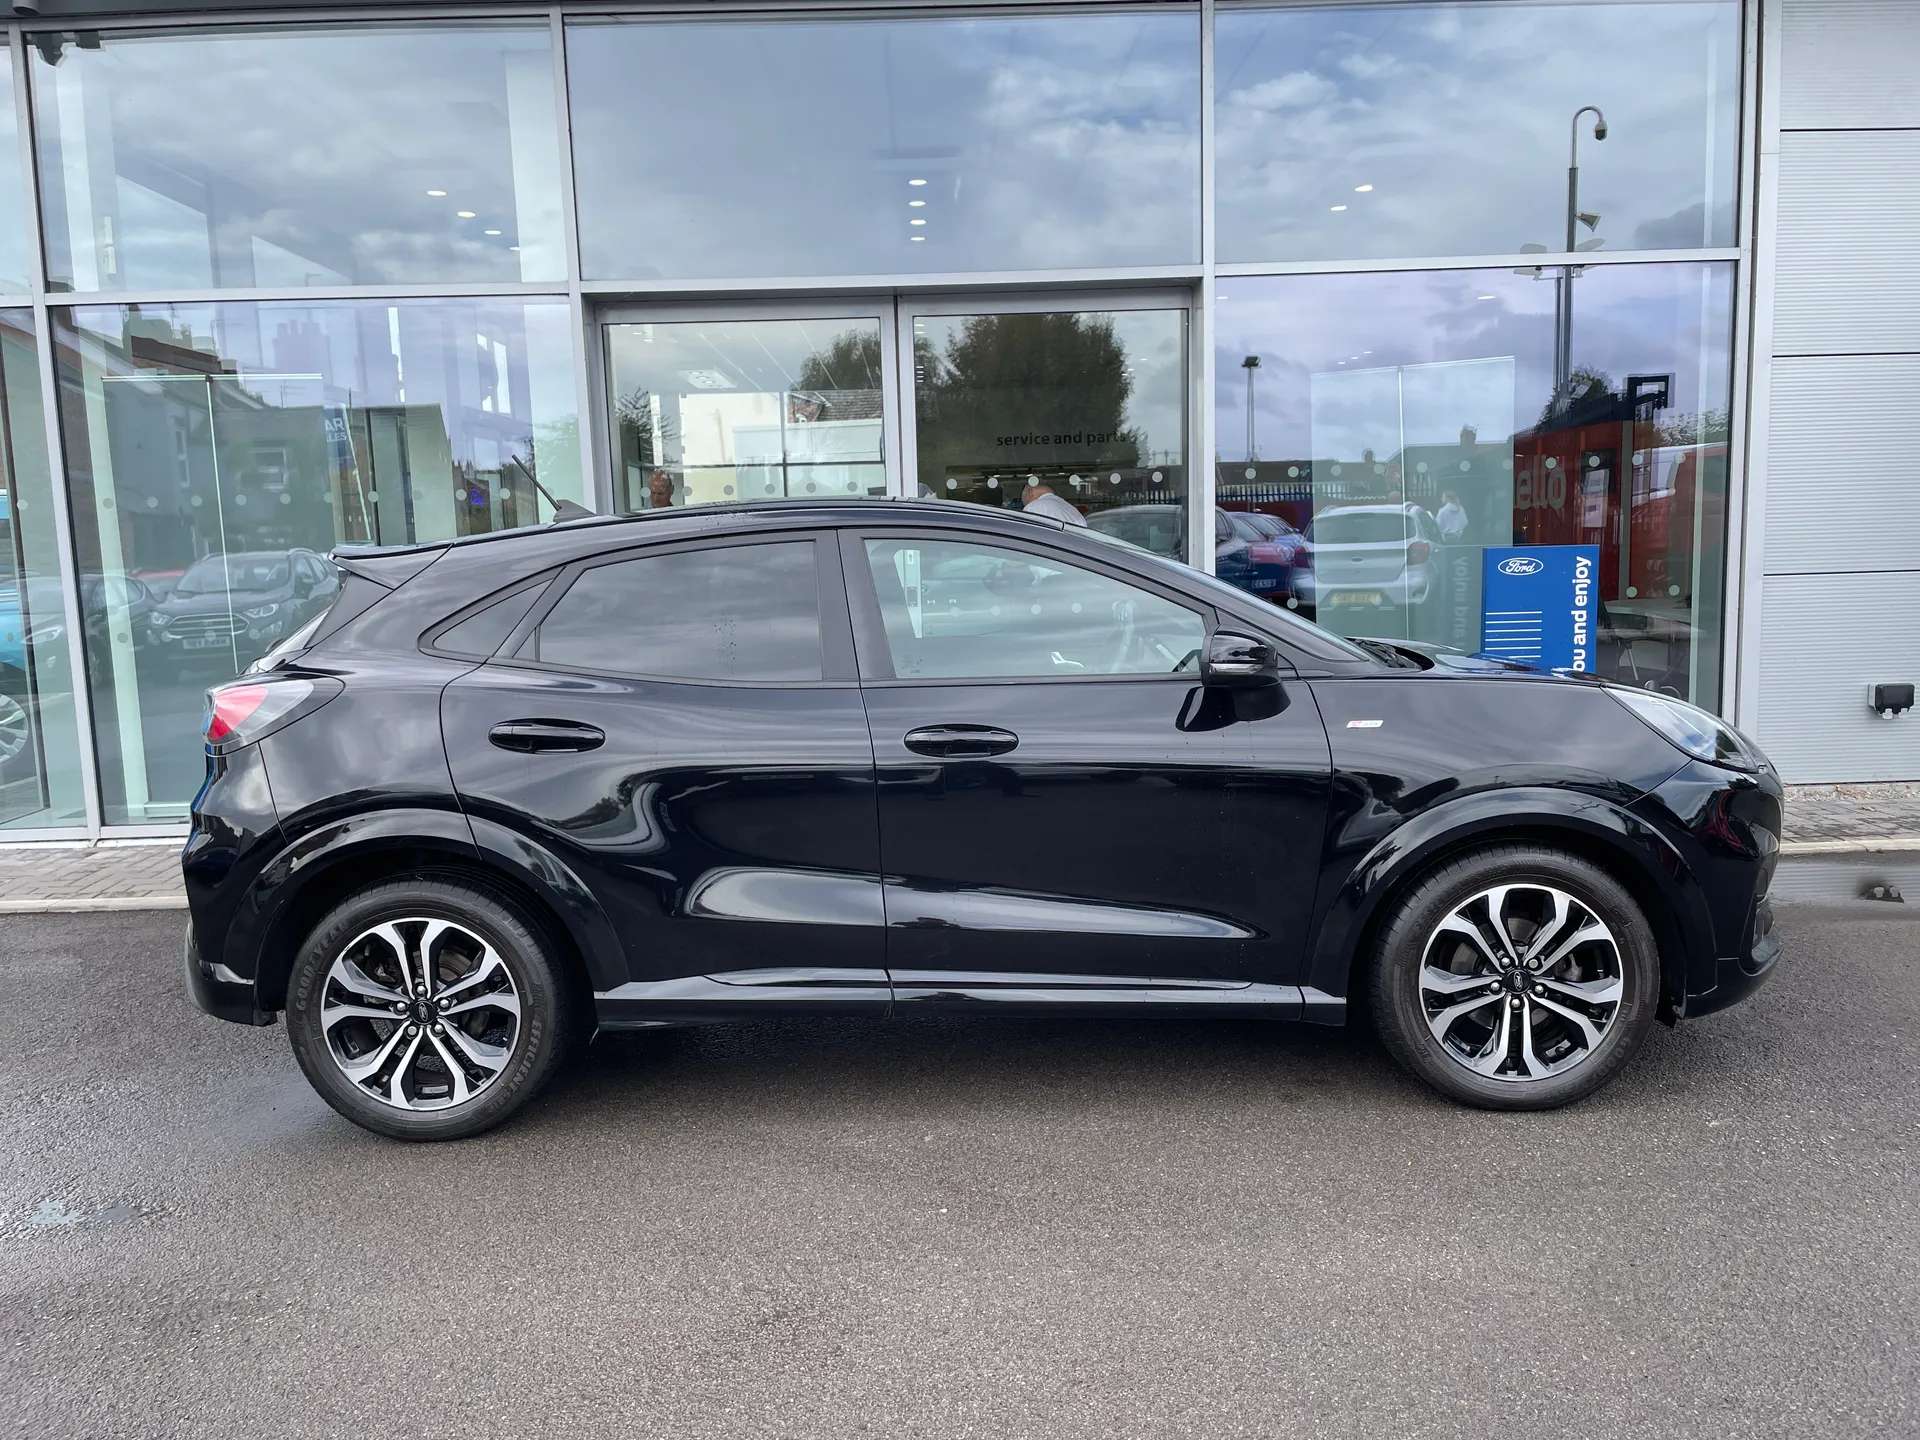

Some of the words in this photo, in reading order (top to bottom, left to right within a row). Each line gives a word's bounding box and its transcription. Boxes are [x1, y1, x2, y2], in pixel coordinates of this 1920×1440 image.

[996, 432, 1050, 446] service
[1053, 431, 1082, 445] and
[1086, 430, 1126, 446] parts
[1504, 558, 1537, 573] Ford
[1572, 556, 1592, 607] enjoy
[1571, 610, 1587, 646] and
